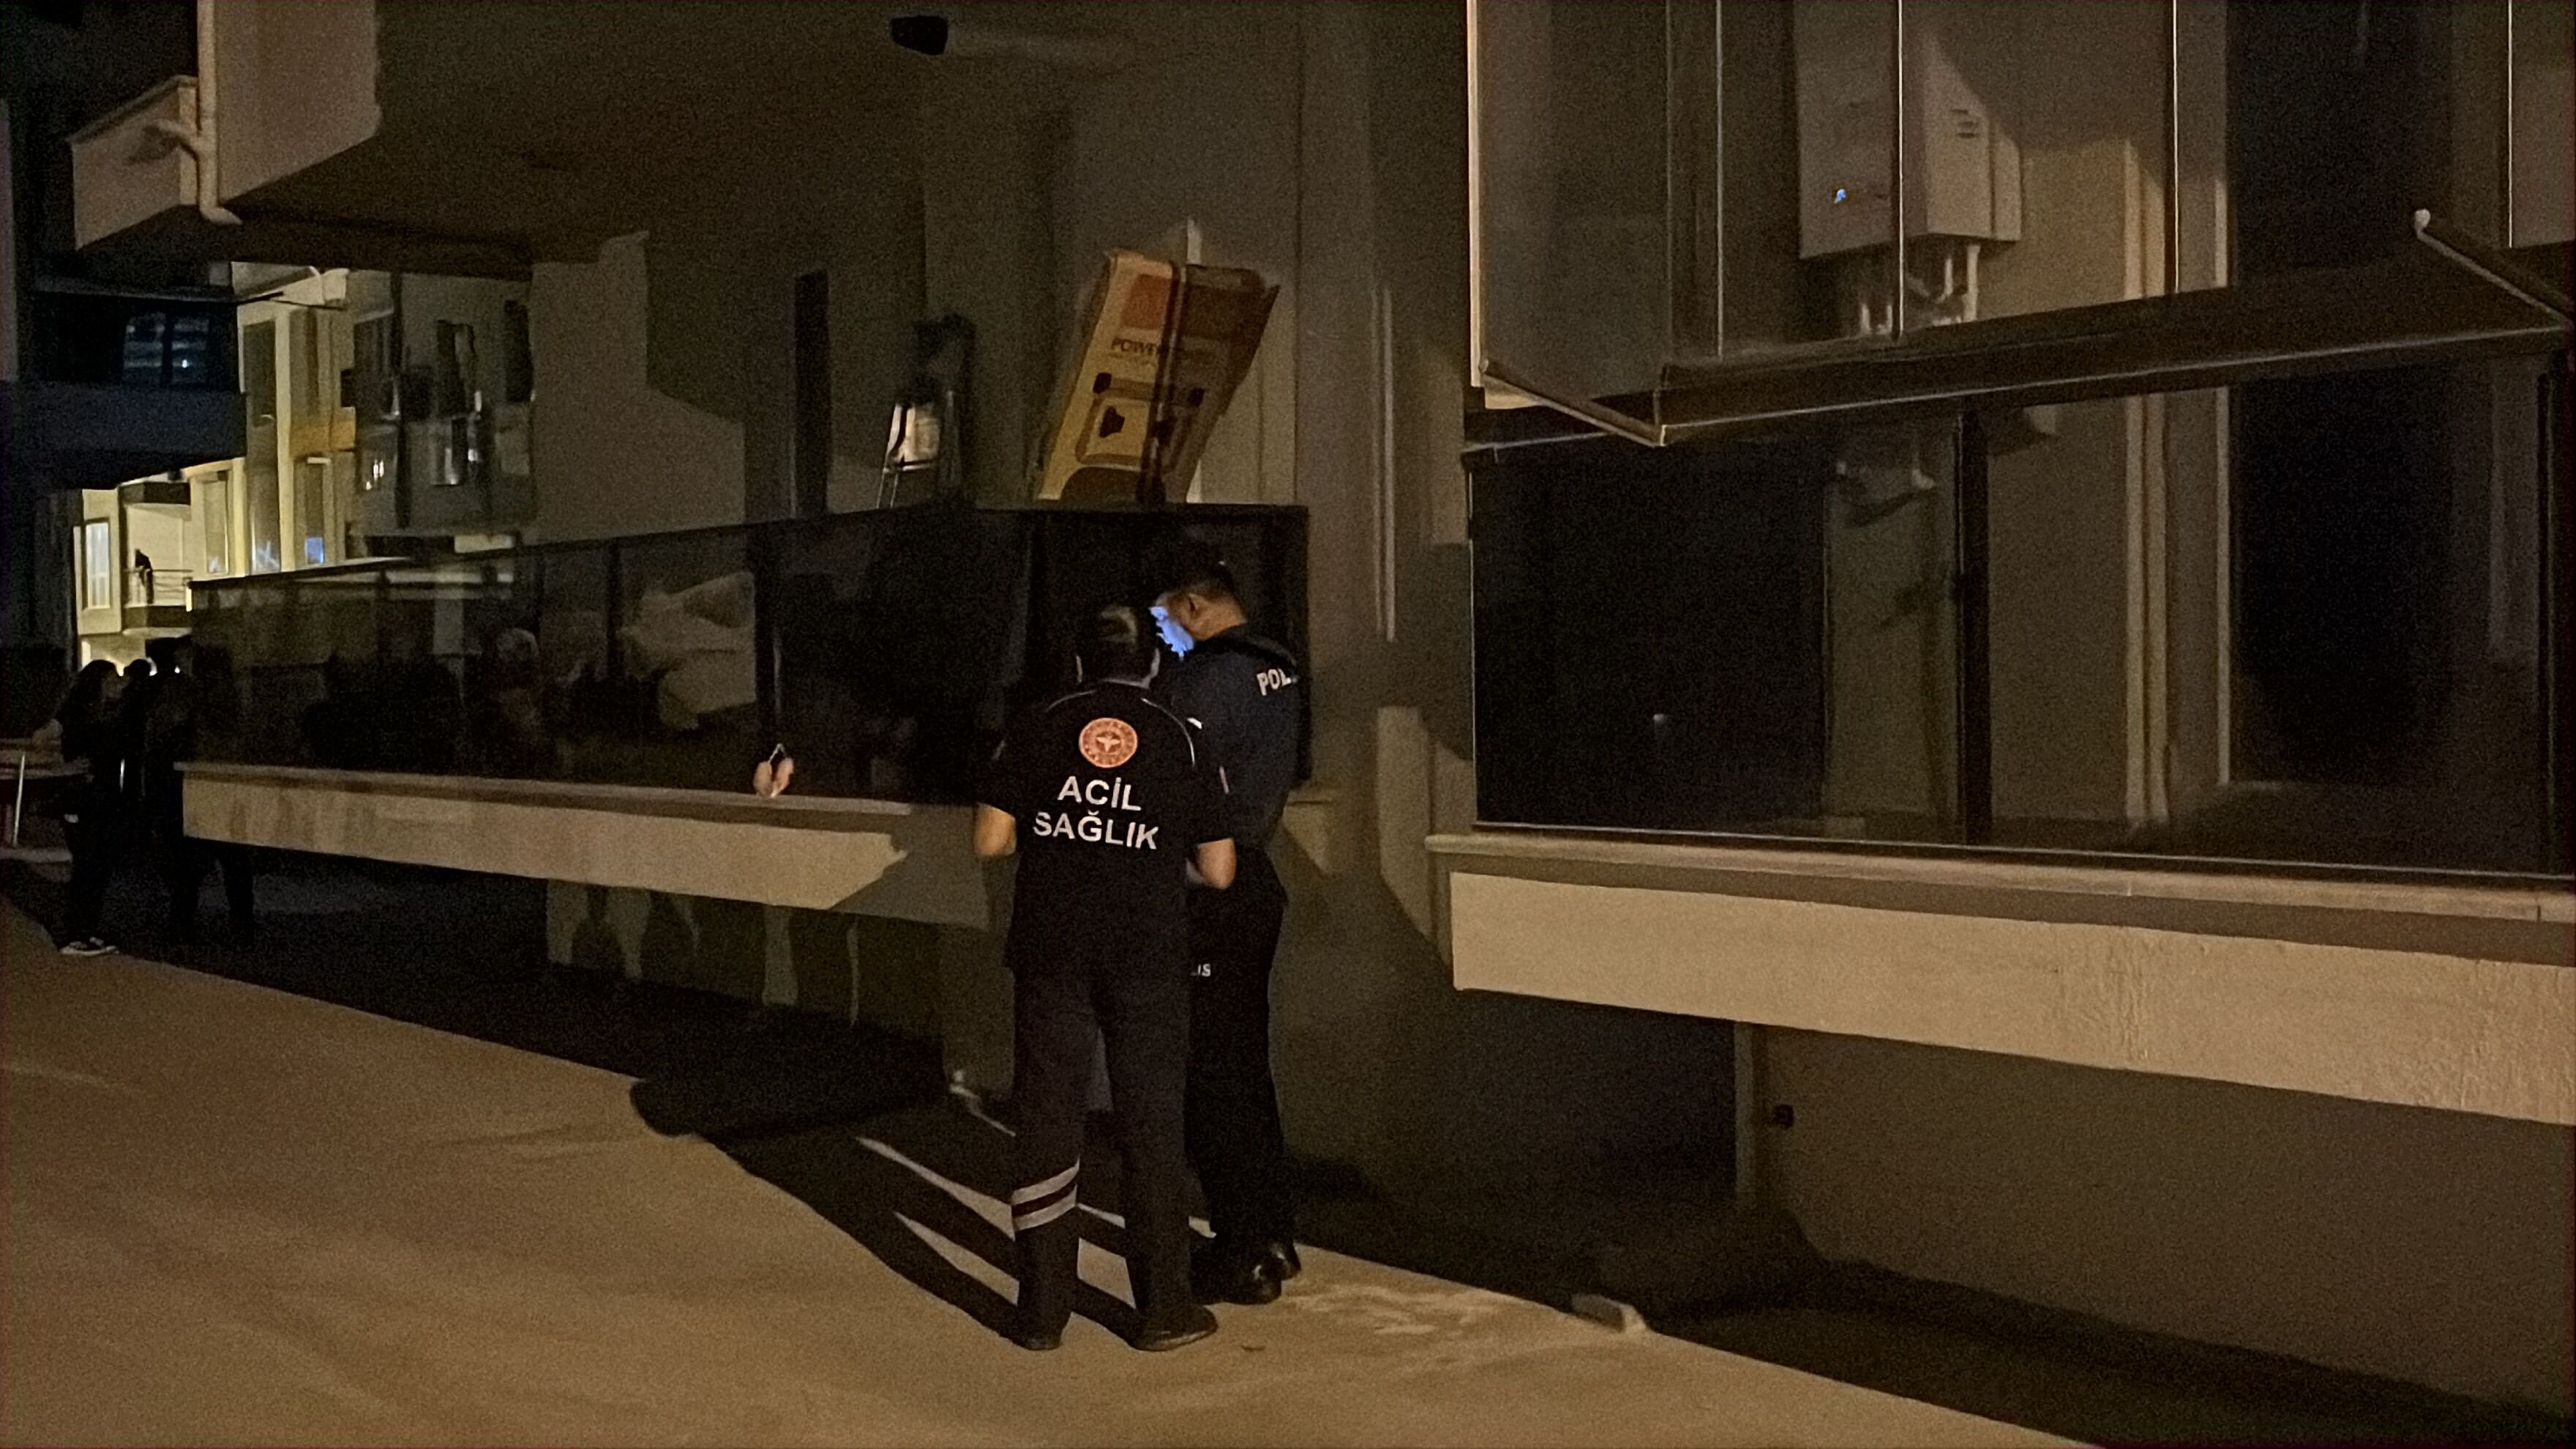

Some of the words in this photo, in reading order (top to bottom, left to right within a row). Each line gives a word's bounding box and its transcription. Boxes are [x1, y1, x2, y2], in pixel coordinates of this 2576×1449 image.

[1257, 668, 1297, 696] POL
[1057, 776, 1142, 812] ACİL
[1033, 809, 1159, 850] SAĞLIK
